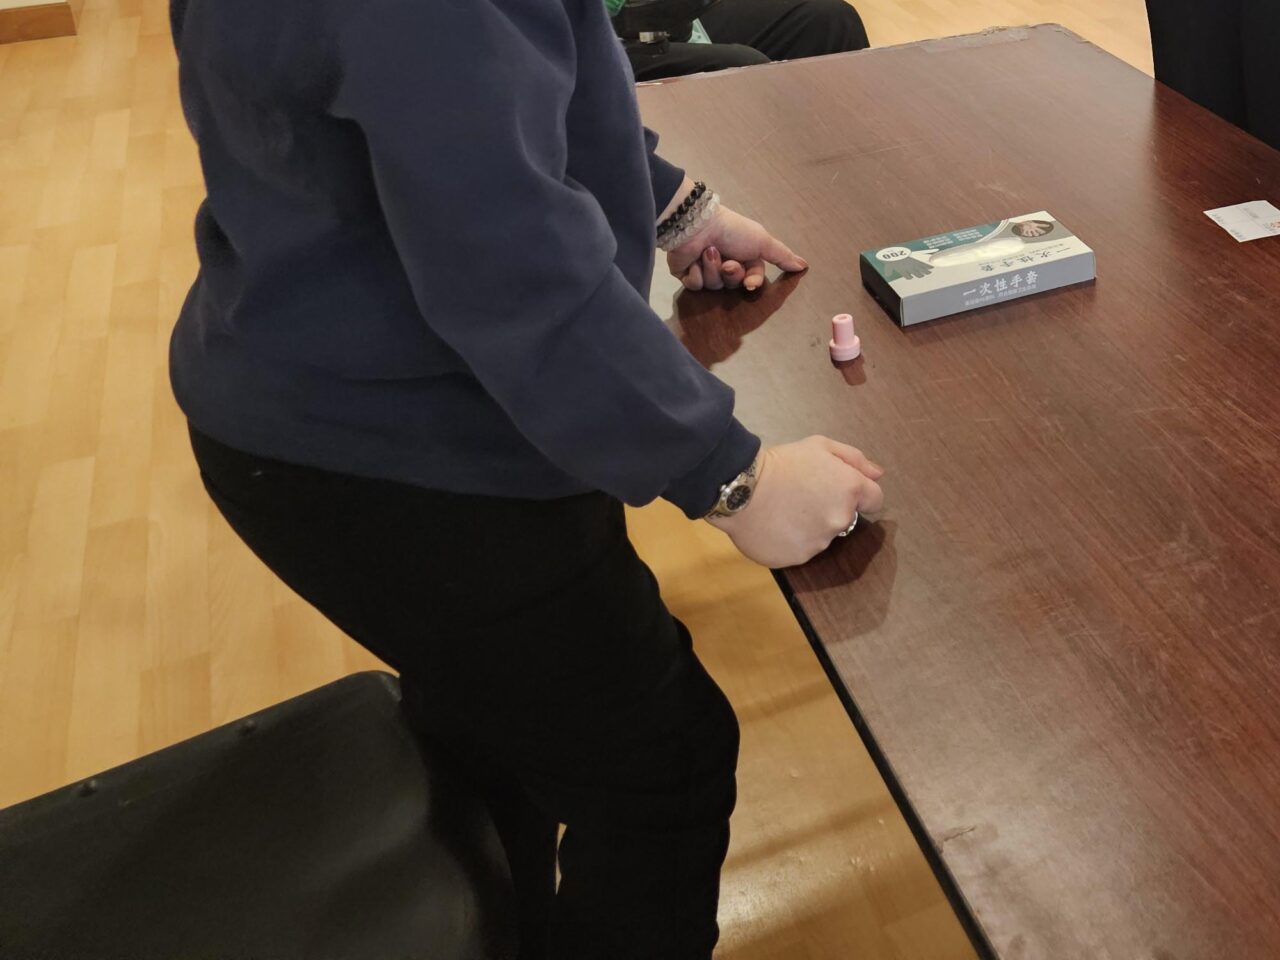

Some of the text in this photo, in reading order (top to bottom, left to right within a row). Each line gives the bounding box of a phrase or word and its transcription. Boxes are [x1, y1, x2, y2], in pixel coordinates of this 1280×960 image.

[963, 271, 1038, 296] 一次性手套
